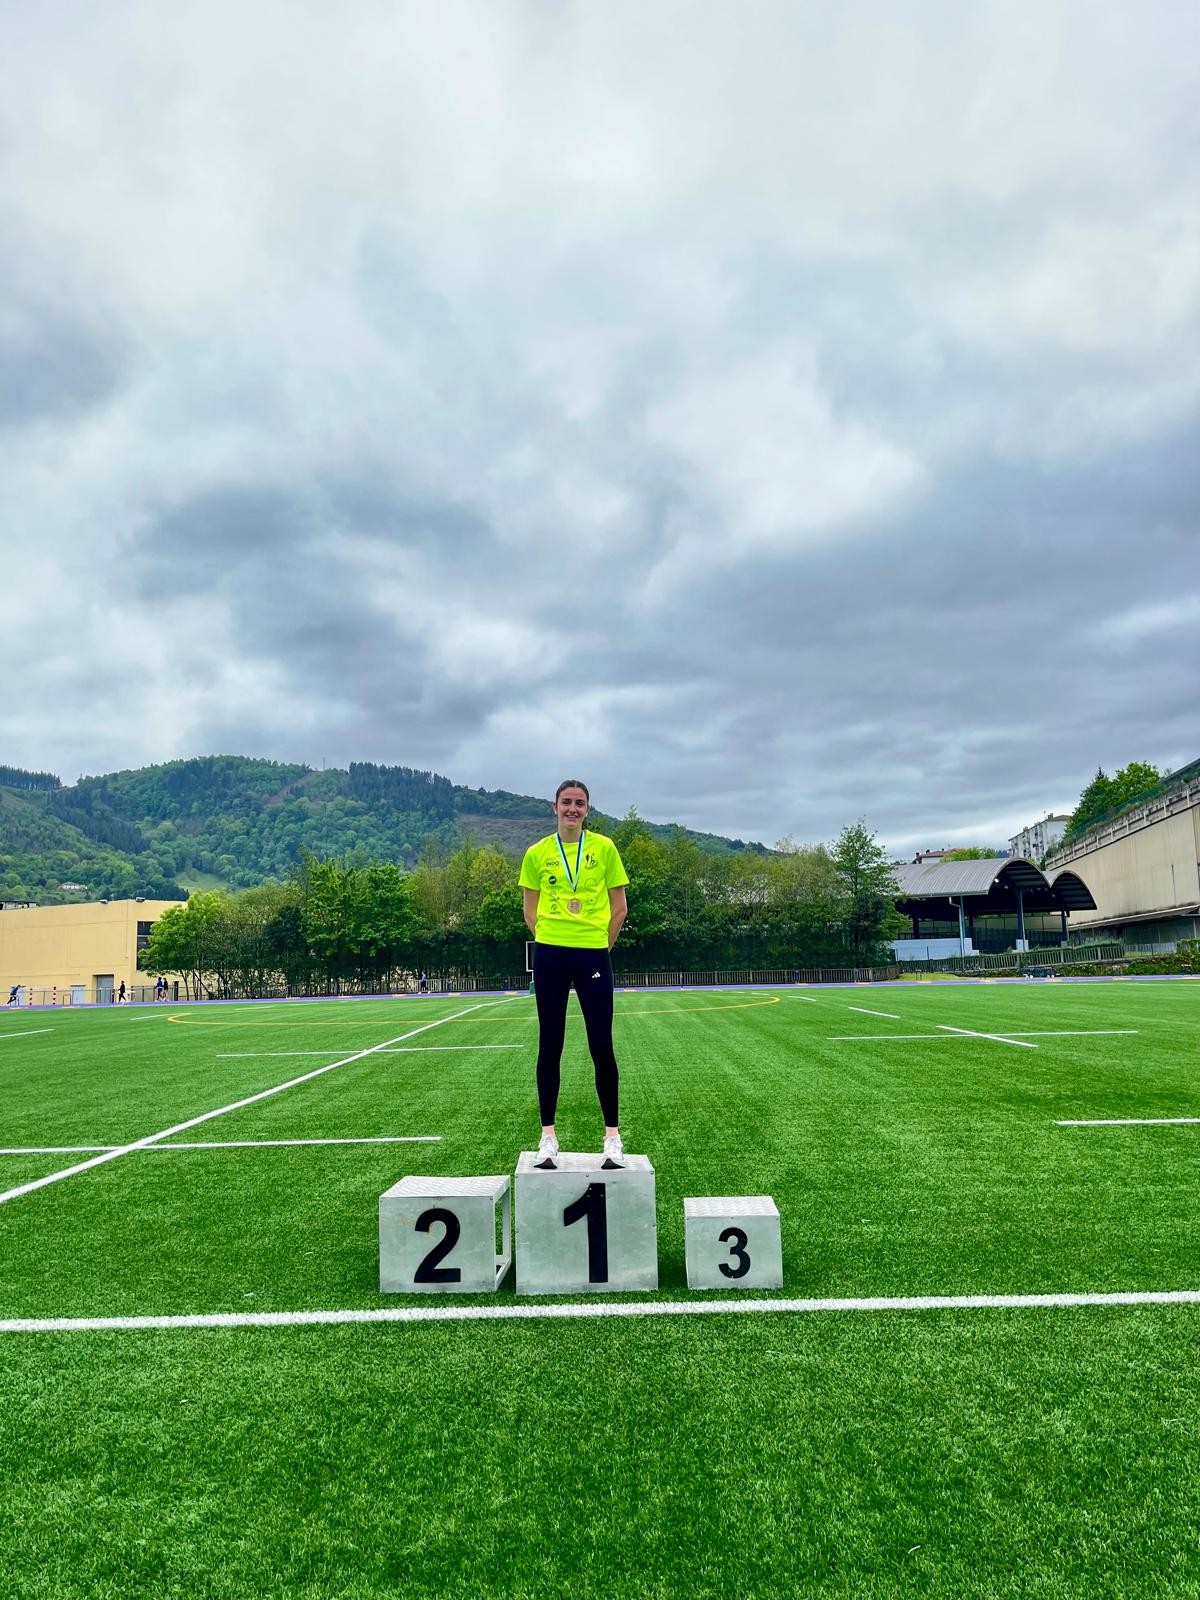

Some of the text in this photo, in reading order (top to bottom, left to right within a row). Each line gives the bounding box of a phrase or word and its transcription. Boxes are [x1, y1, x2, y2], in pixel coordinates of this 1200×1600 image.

[414, 1208, 461, 1283] 2
[563, 1183, 608, 1283] 1
[718, 1227, 751, 1279] 3
